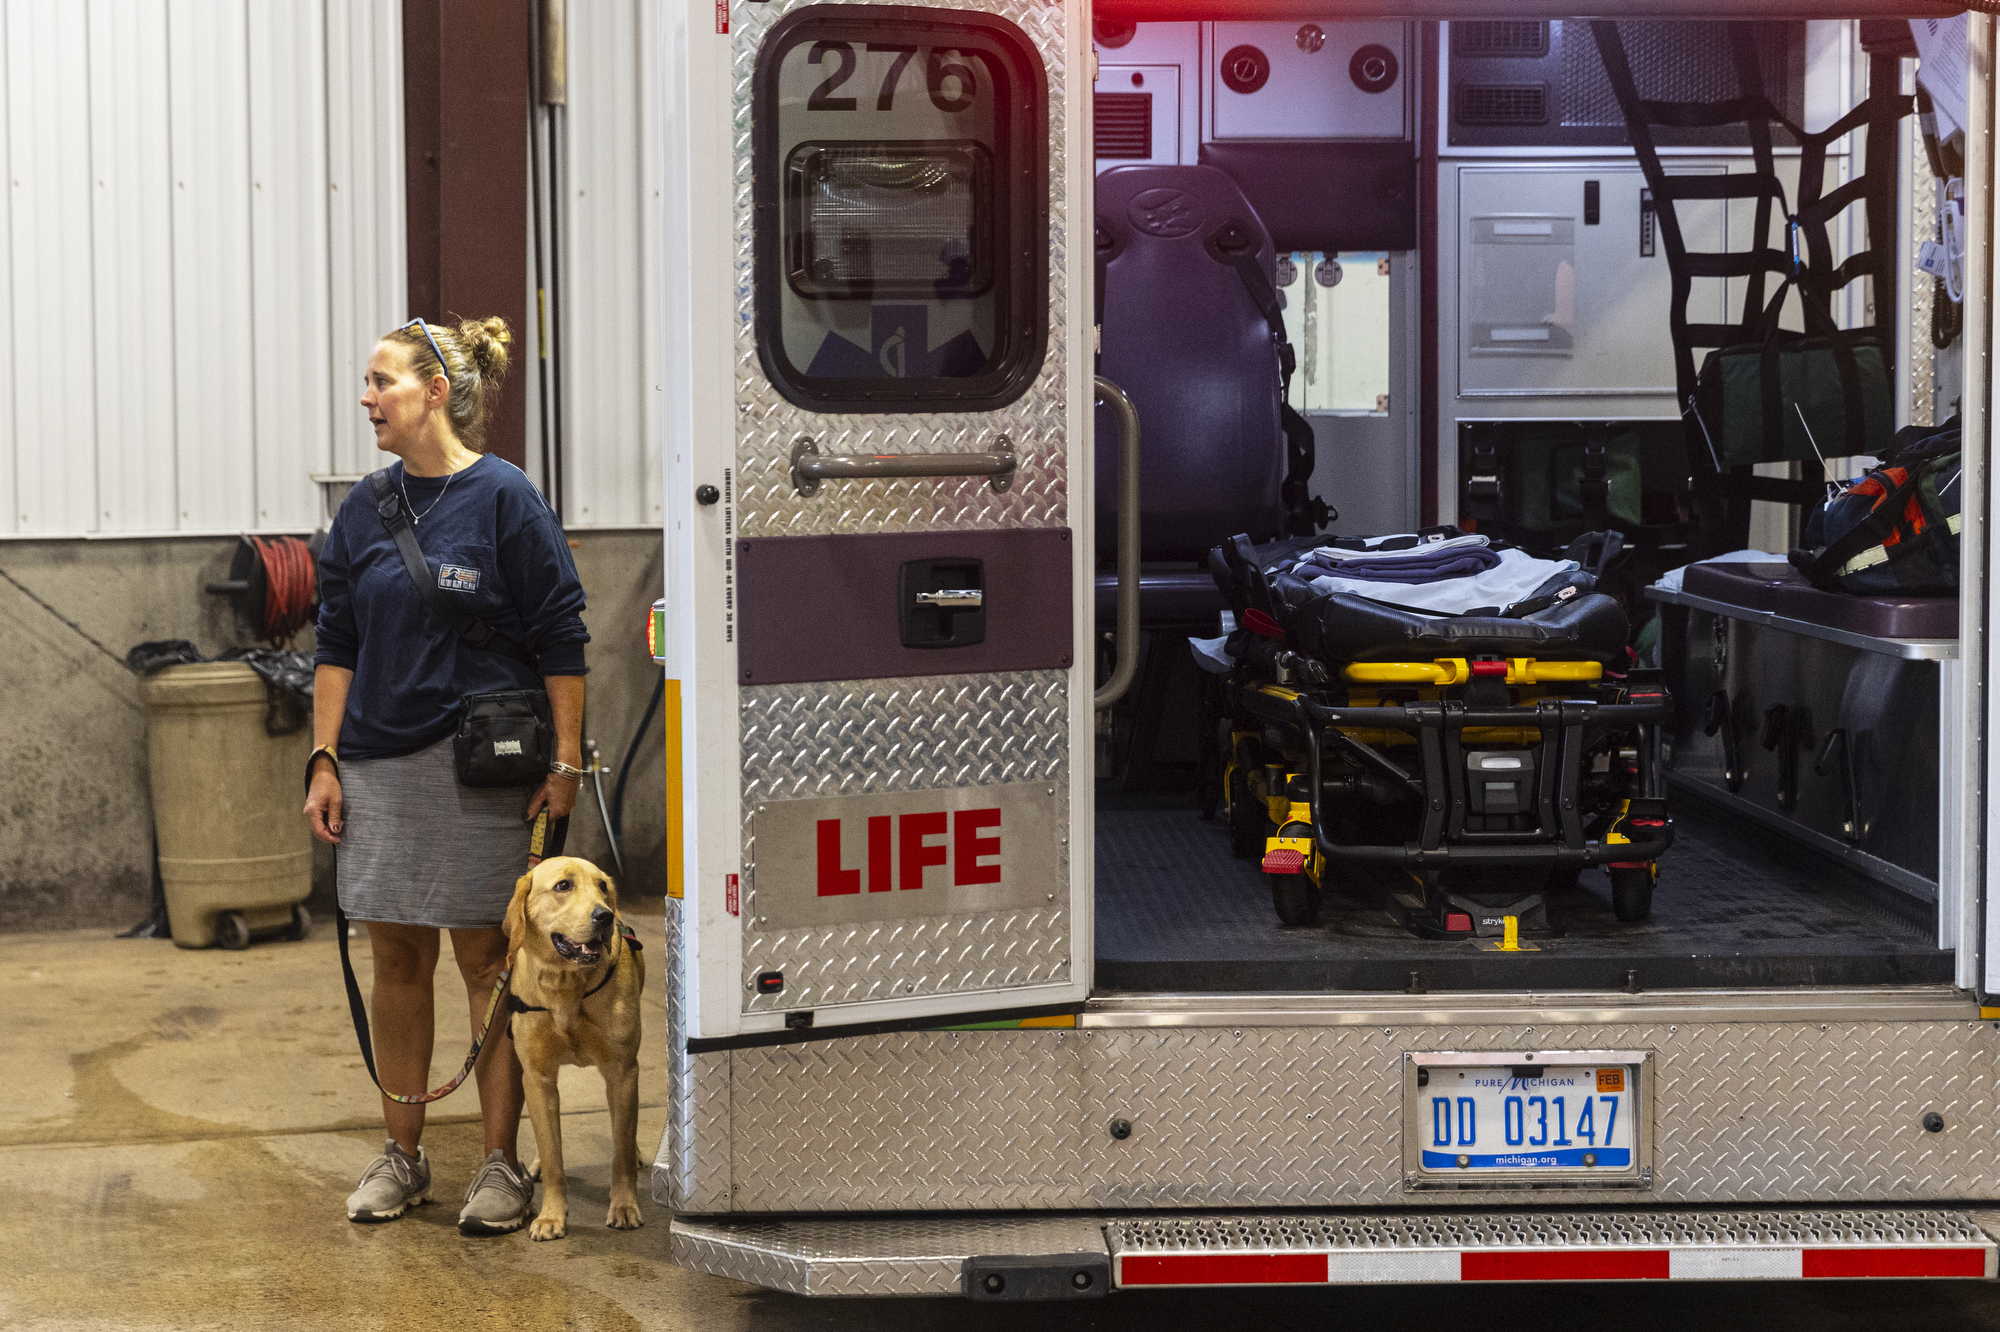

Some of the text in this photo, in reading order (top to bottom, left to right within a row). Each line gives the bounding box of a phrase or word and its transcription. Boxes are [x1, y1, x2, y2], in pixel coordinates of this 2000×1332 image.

[806, 39, 976, 113] 276
[817, 808, 1001, 897] LIFE
[1482, 917, 1505, 926] stryk
[1475, 1079, 1503, 1087] PURE
[1598, 1074, 1620, 1086] FEB
[1432, 1095, 1619, 1146] DD 03147
[1495, 1155, 1557, 1166] michigan.org
